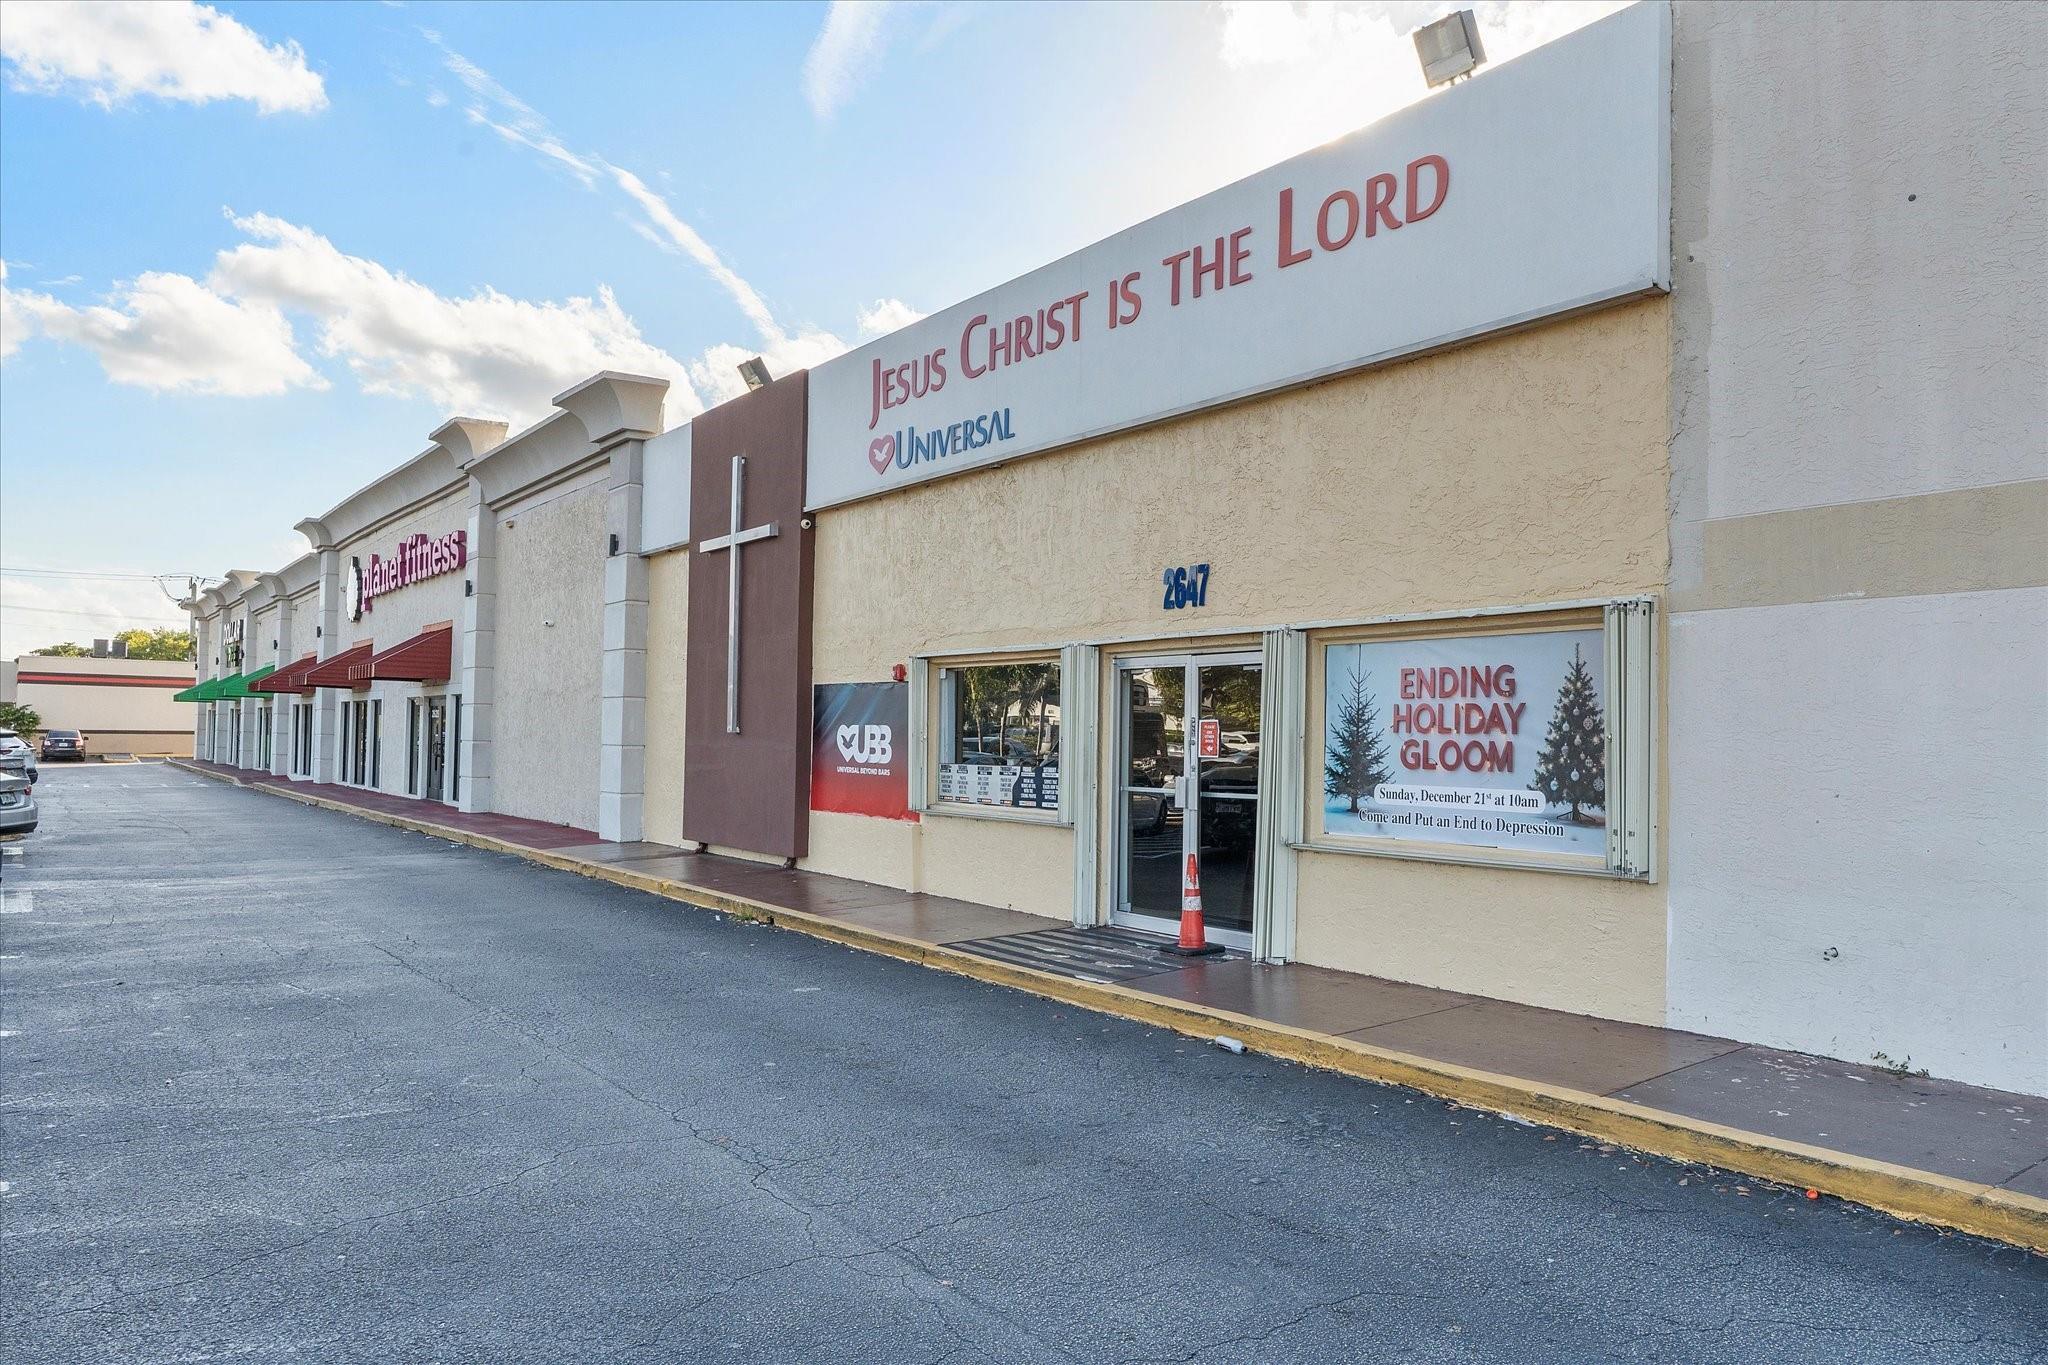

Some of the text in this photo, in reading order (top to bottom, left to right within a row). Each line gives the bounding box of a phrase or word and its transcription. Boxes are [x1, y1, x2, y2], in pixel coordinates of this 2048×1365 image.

[869, 154, 1451, 430] JESUS CHRIST IS THE LORD
[895, 408, 1016, 470] UNIVERSAL
[361, 530, 467, 613] planet fitness
[1163, 563, 1210, 610] 2647
[1400, 664, 1516, 699] ENDING
[1392, 702, 1526, 735] HOLIDAY
[836, 766, 891, 776] UNIVERSAL BEYOND BARS
[1400, 739, 1514, 773] GLOOM
[1379, 787, 1539, 808] Sunday, December 21st at 10am
[1358, 810, 1564, 836] Come and Put an End to Depression
